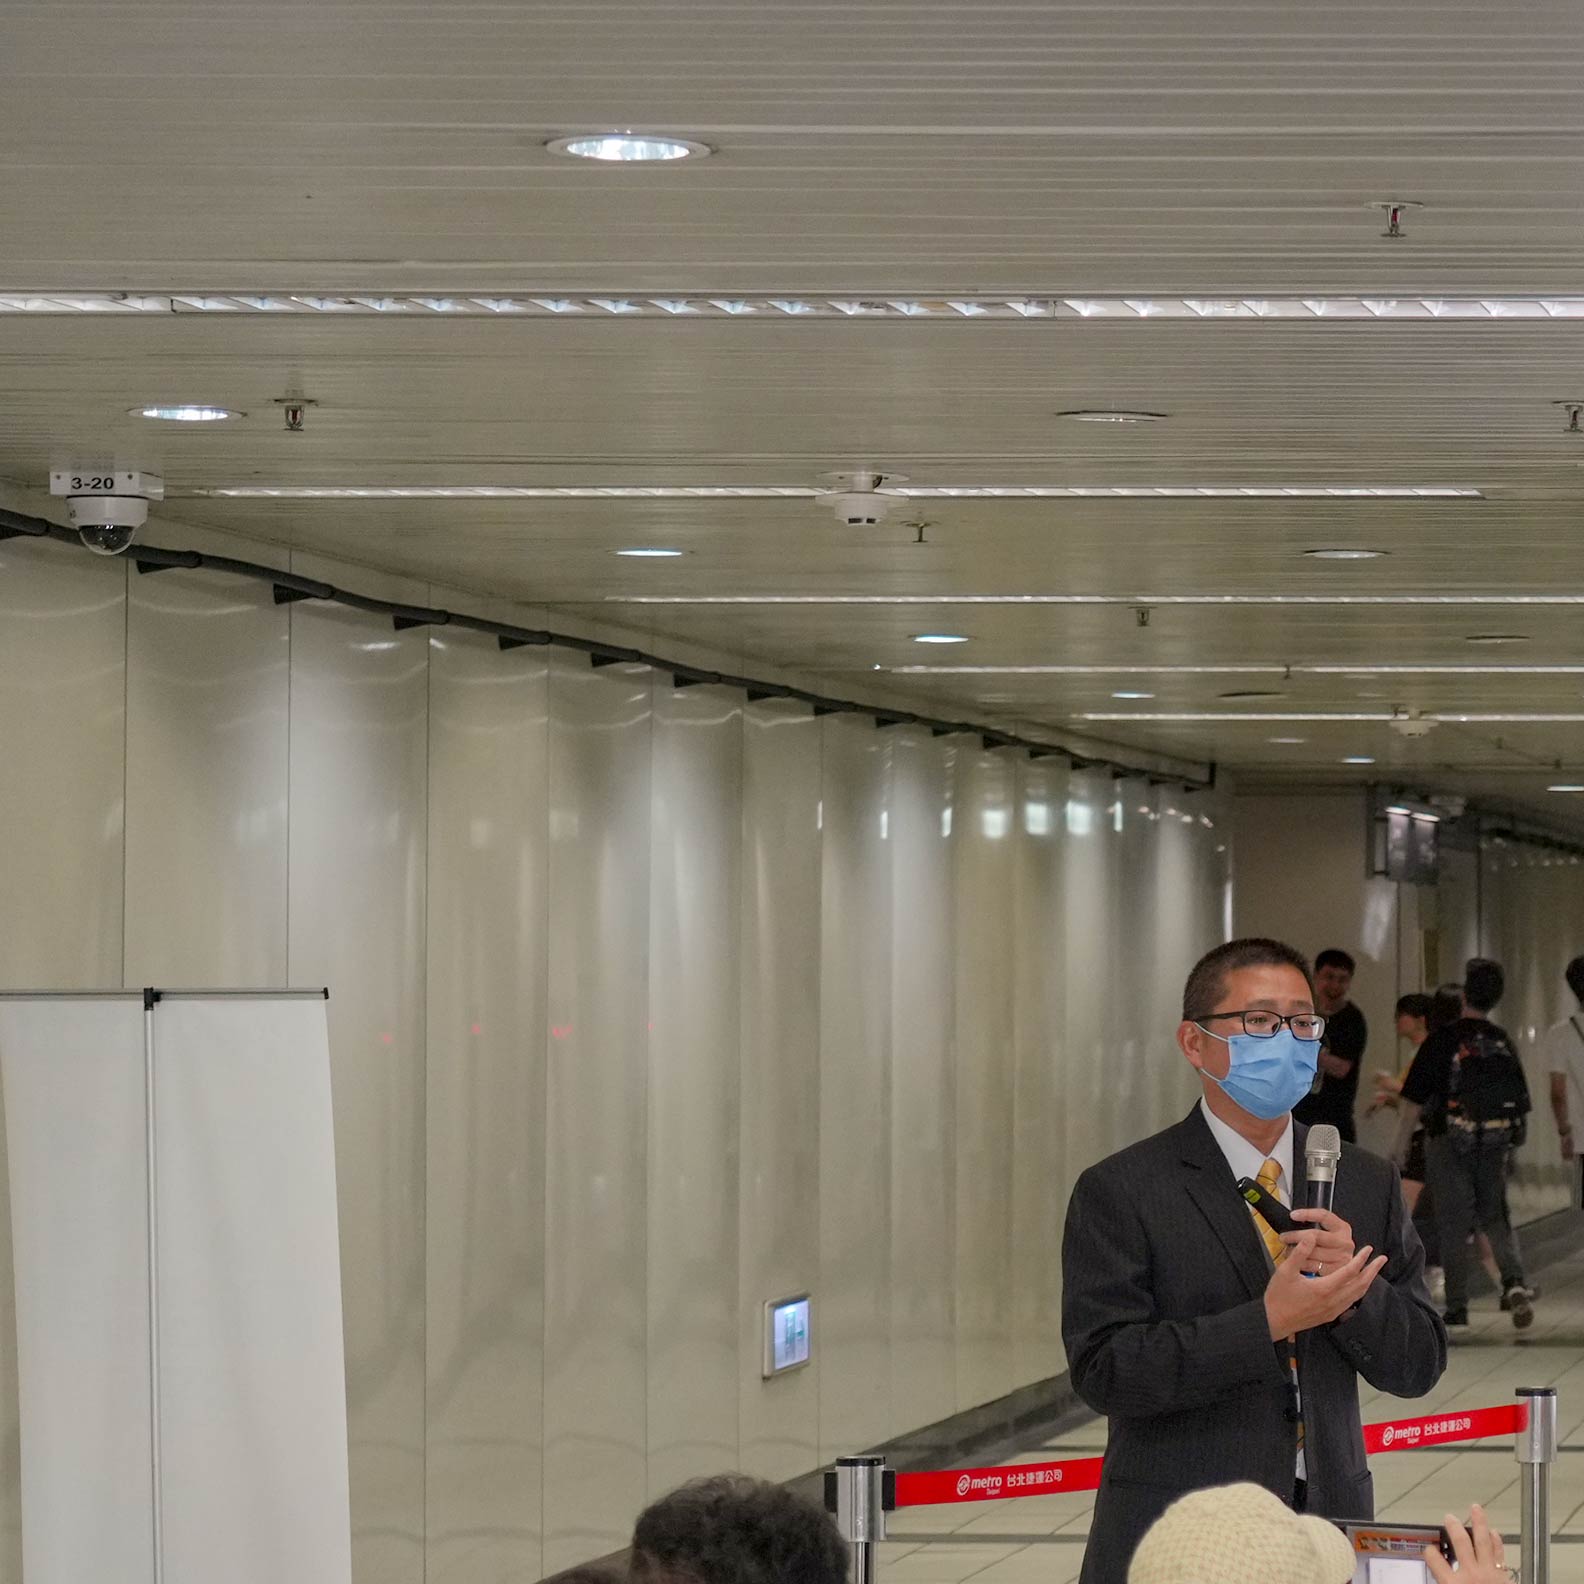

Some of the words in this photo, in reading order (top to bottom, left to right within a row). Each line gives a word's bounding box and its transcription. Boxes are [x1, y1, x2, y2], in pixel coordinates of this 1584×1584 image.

[71, 477, 114, 490] 3-20
[1395, 1426, 1421, 1440] metro
[971, 1475, 1003, 1490] metro
[1006, 1469, 1063, 1488] 台北捷運公司
